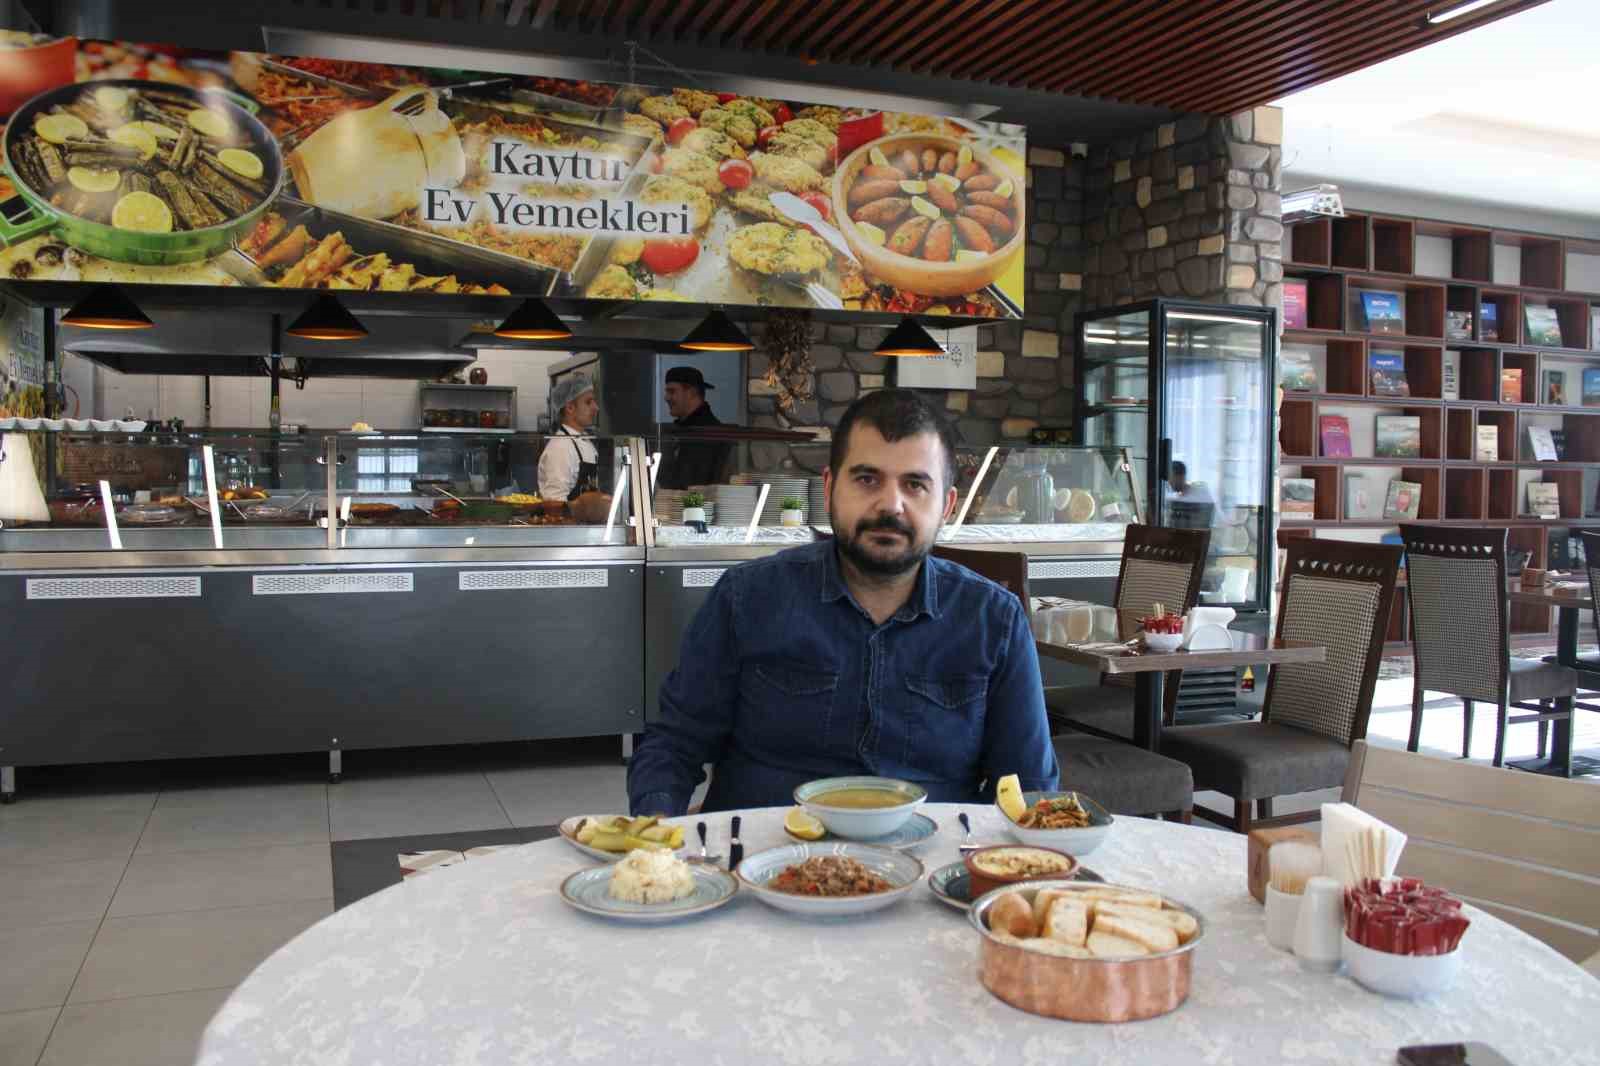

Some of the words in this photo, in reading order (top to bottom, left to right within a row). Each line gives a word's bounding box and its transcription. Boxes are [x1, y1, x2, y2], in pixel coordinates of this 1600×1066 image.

[492, 141, 627, 184] Kaytur
[424, 188, 476, 223] Ev
[486, 191, 690, 234] Yemekleri
